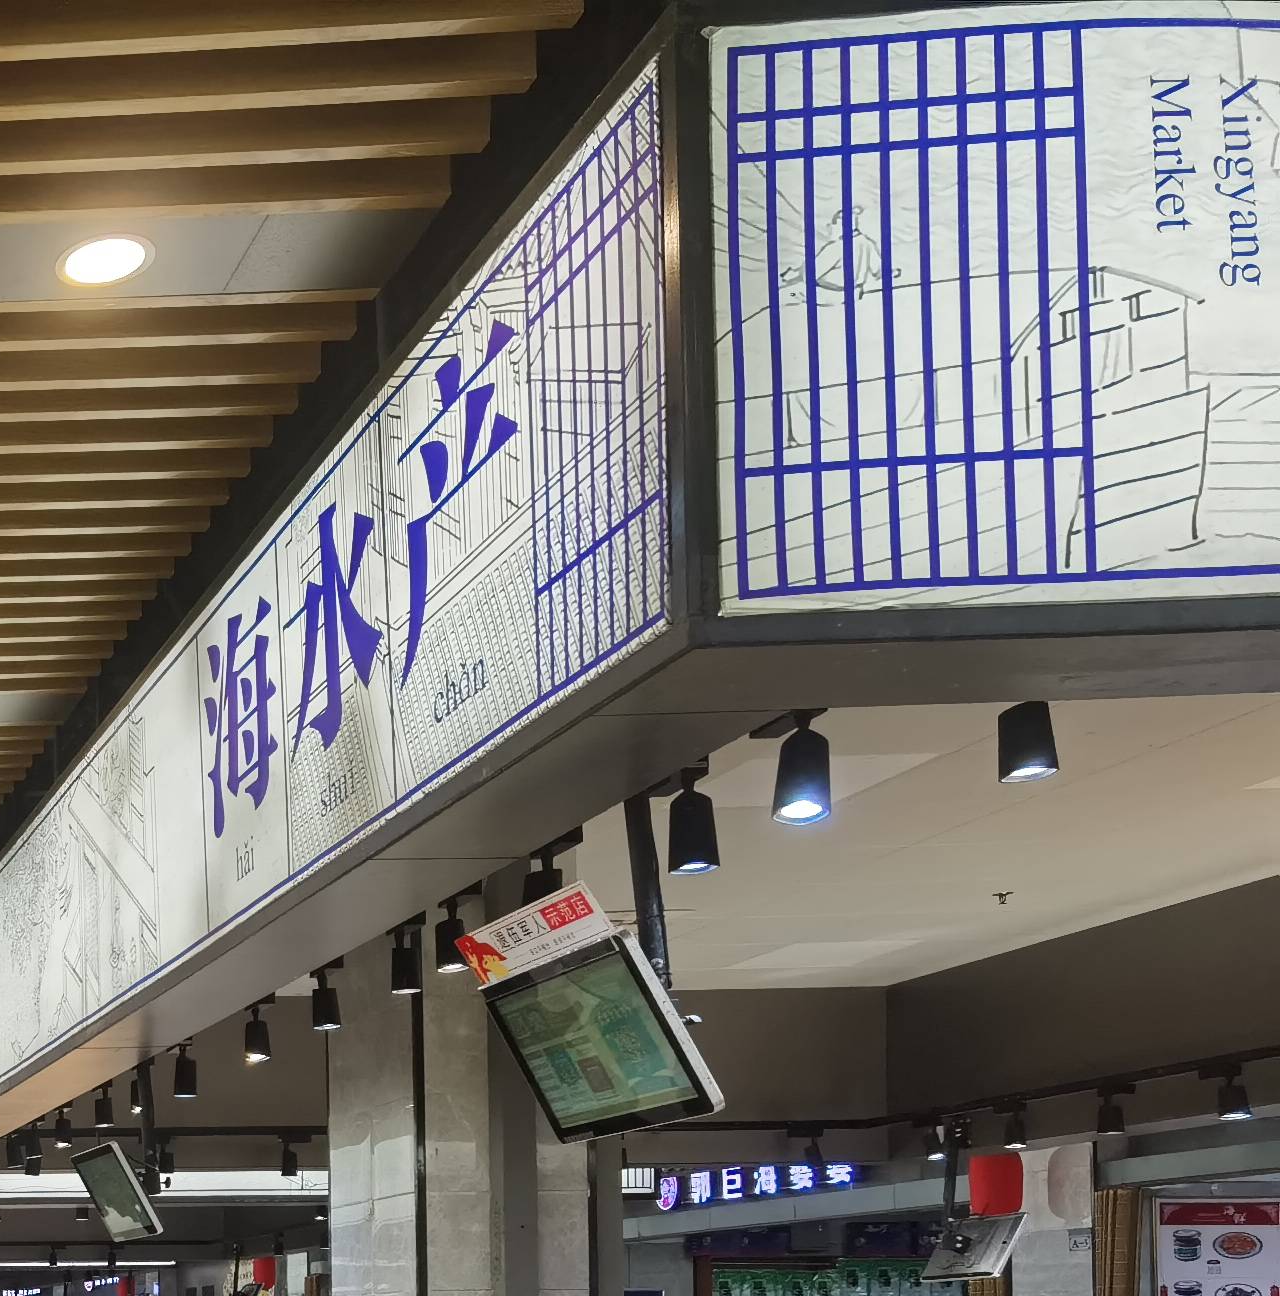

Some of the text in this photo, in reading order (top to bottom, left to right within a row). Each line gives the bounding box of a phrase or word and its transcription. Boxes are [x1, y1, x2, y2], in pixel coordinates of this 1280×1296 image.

[1150, 75, 1193, 232] Market
[1213, 74, 1262, 286] Xingyang
[205, 320, 518, 838] 海水产
